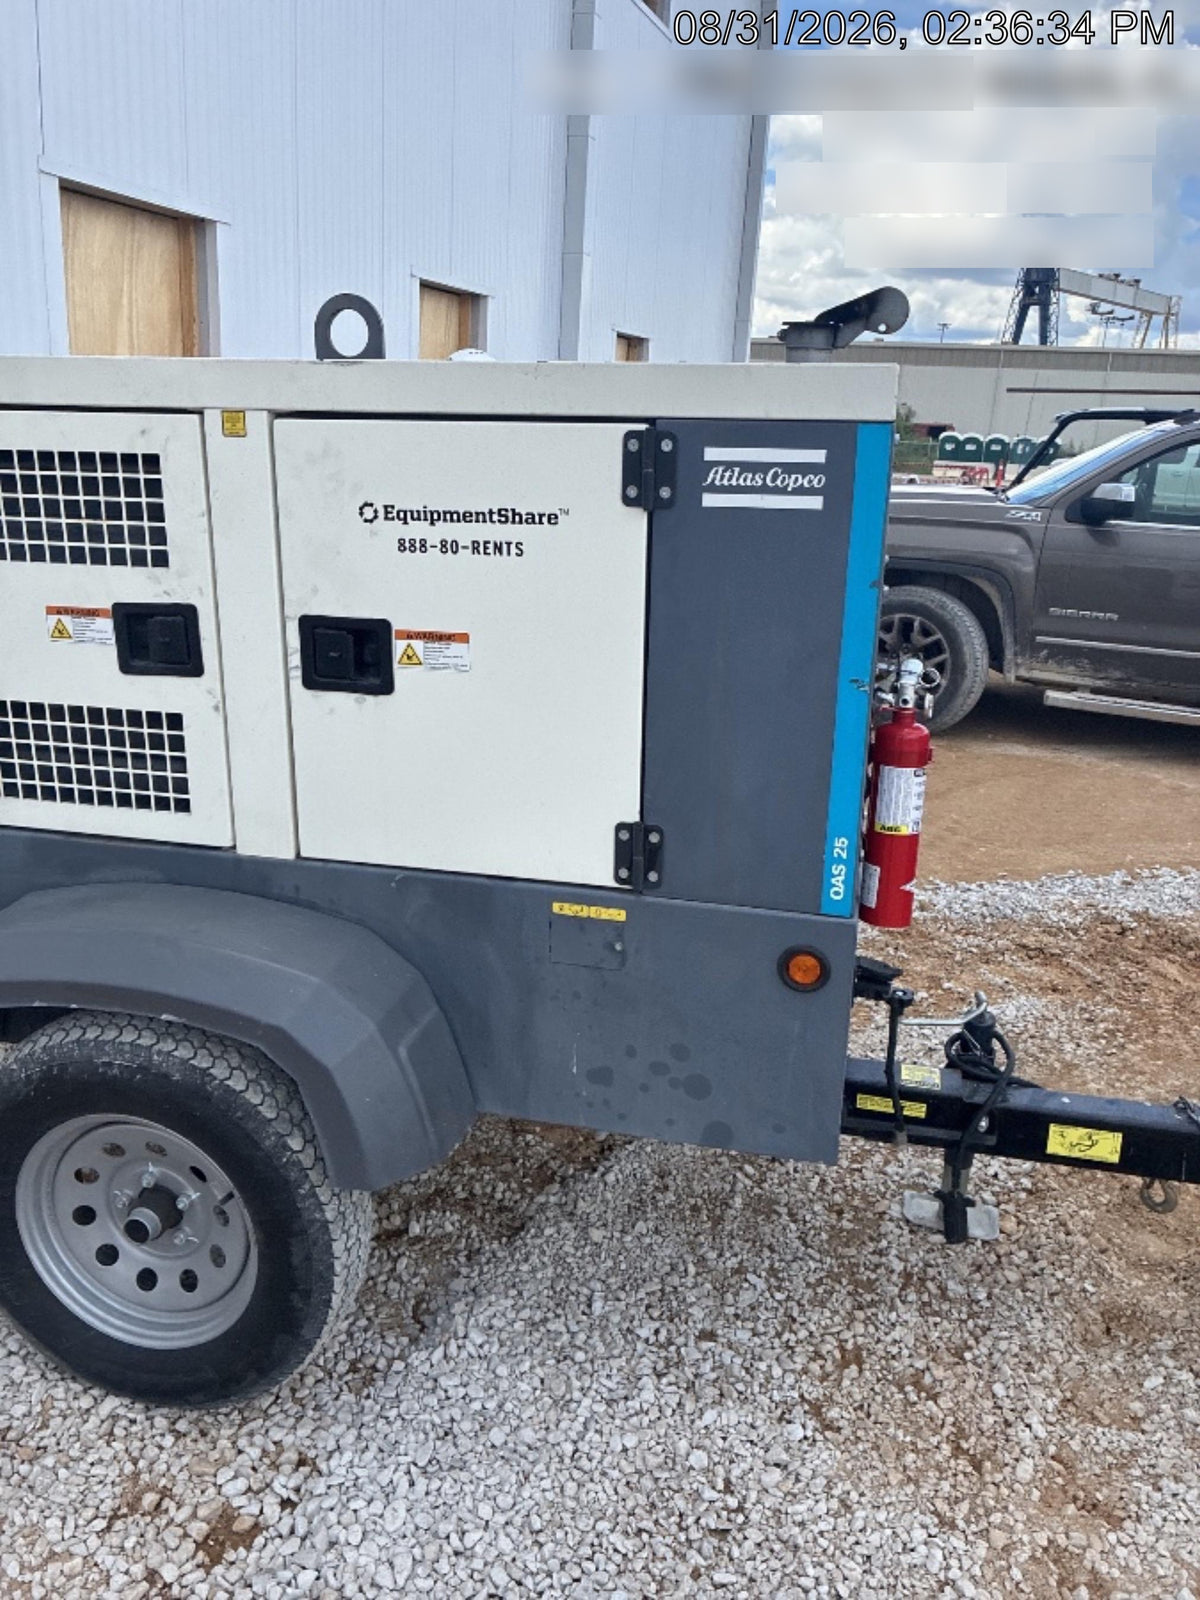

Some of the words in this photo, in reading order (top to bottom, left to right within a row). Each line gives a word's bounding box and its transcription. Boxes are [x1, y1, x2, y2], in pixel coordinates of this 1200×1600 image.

[702, 465, 764, 486] Atlas
[765, 466, 826, 491] Copco
[397, 538, 525, 557] 888-80-RENTS
[1049, 606, 1120, 622] SIERRA
[833, 836, 849, 859] 25
[829, 863, 847, 901] QAS
